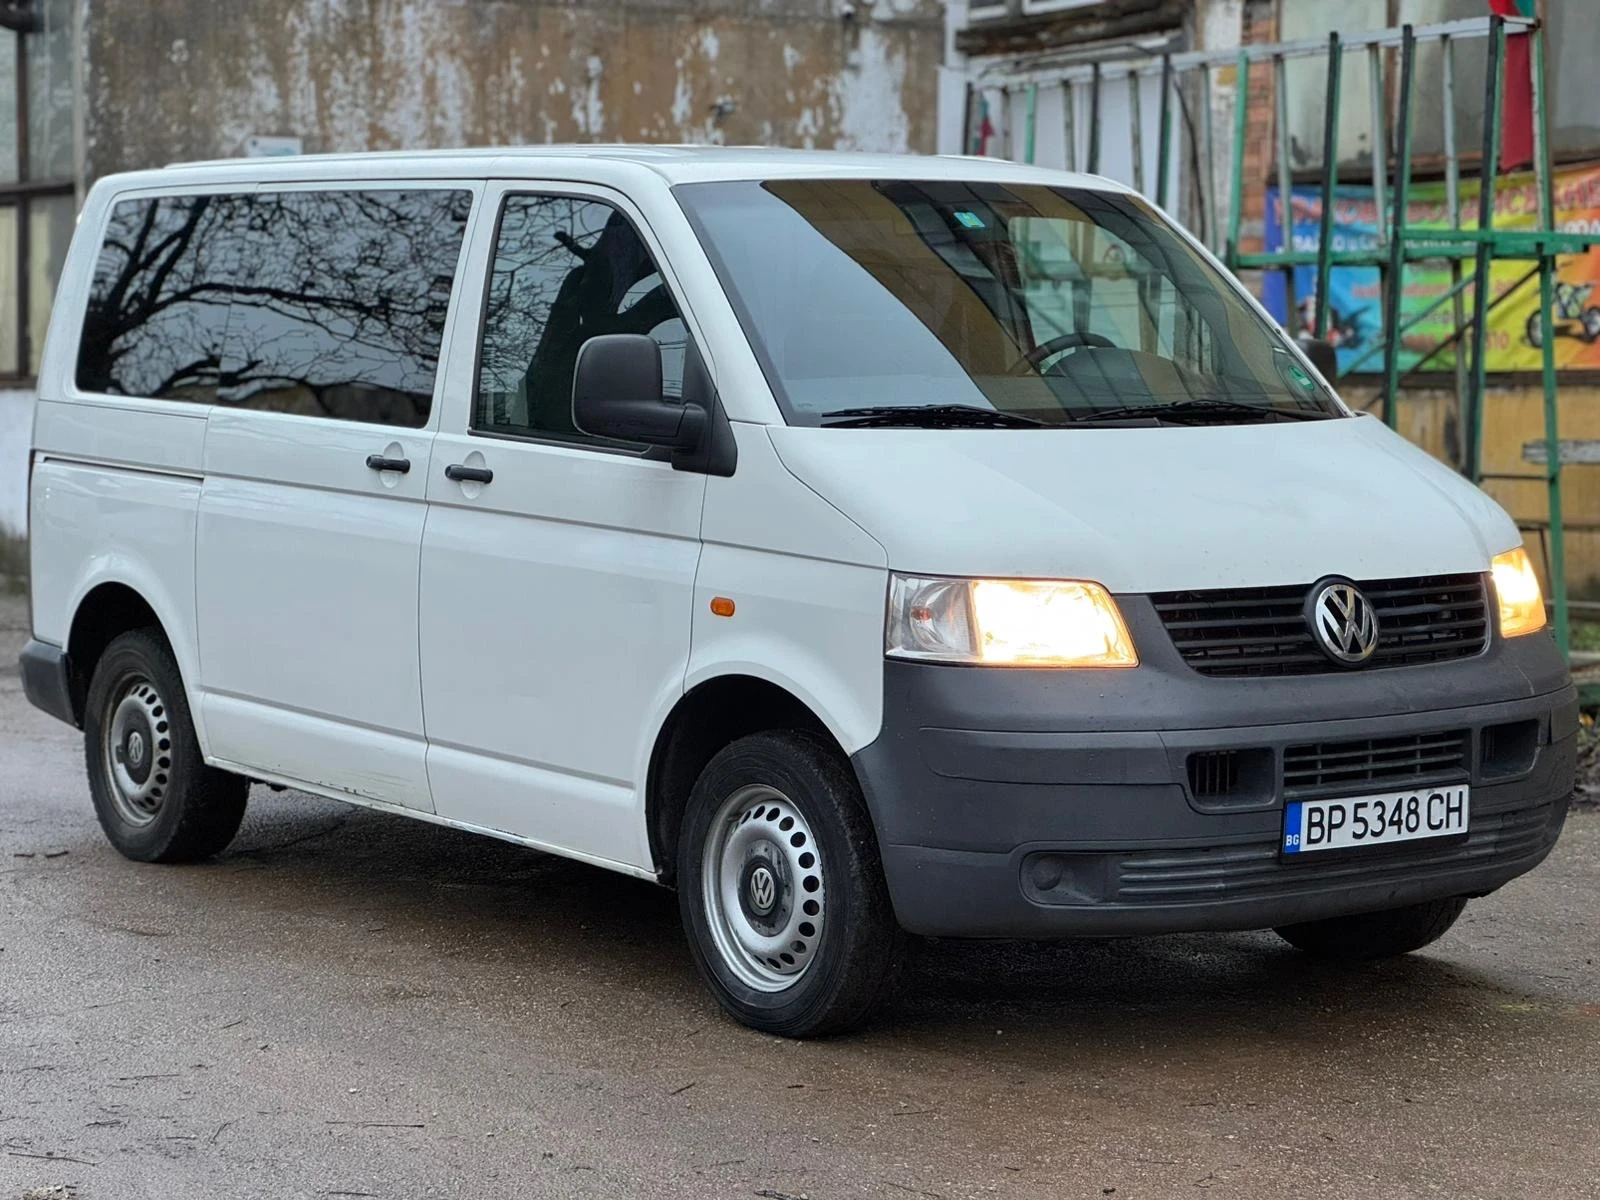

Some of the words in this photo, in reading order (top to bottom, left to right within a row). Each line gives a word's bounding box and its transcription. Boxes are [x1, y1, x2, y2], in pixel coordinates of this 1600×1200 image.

[1317, 585, 1376, 659] VW
[1286, 834, 1300, 846] BG
[1306, 804, 1346, 845] BP
[1352, 796, 1420, 839] 5348
[1427, 790, 1463, 830] CH
[752, 868, 775, 908] VW
